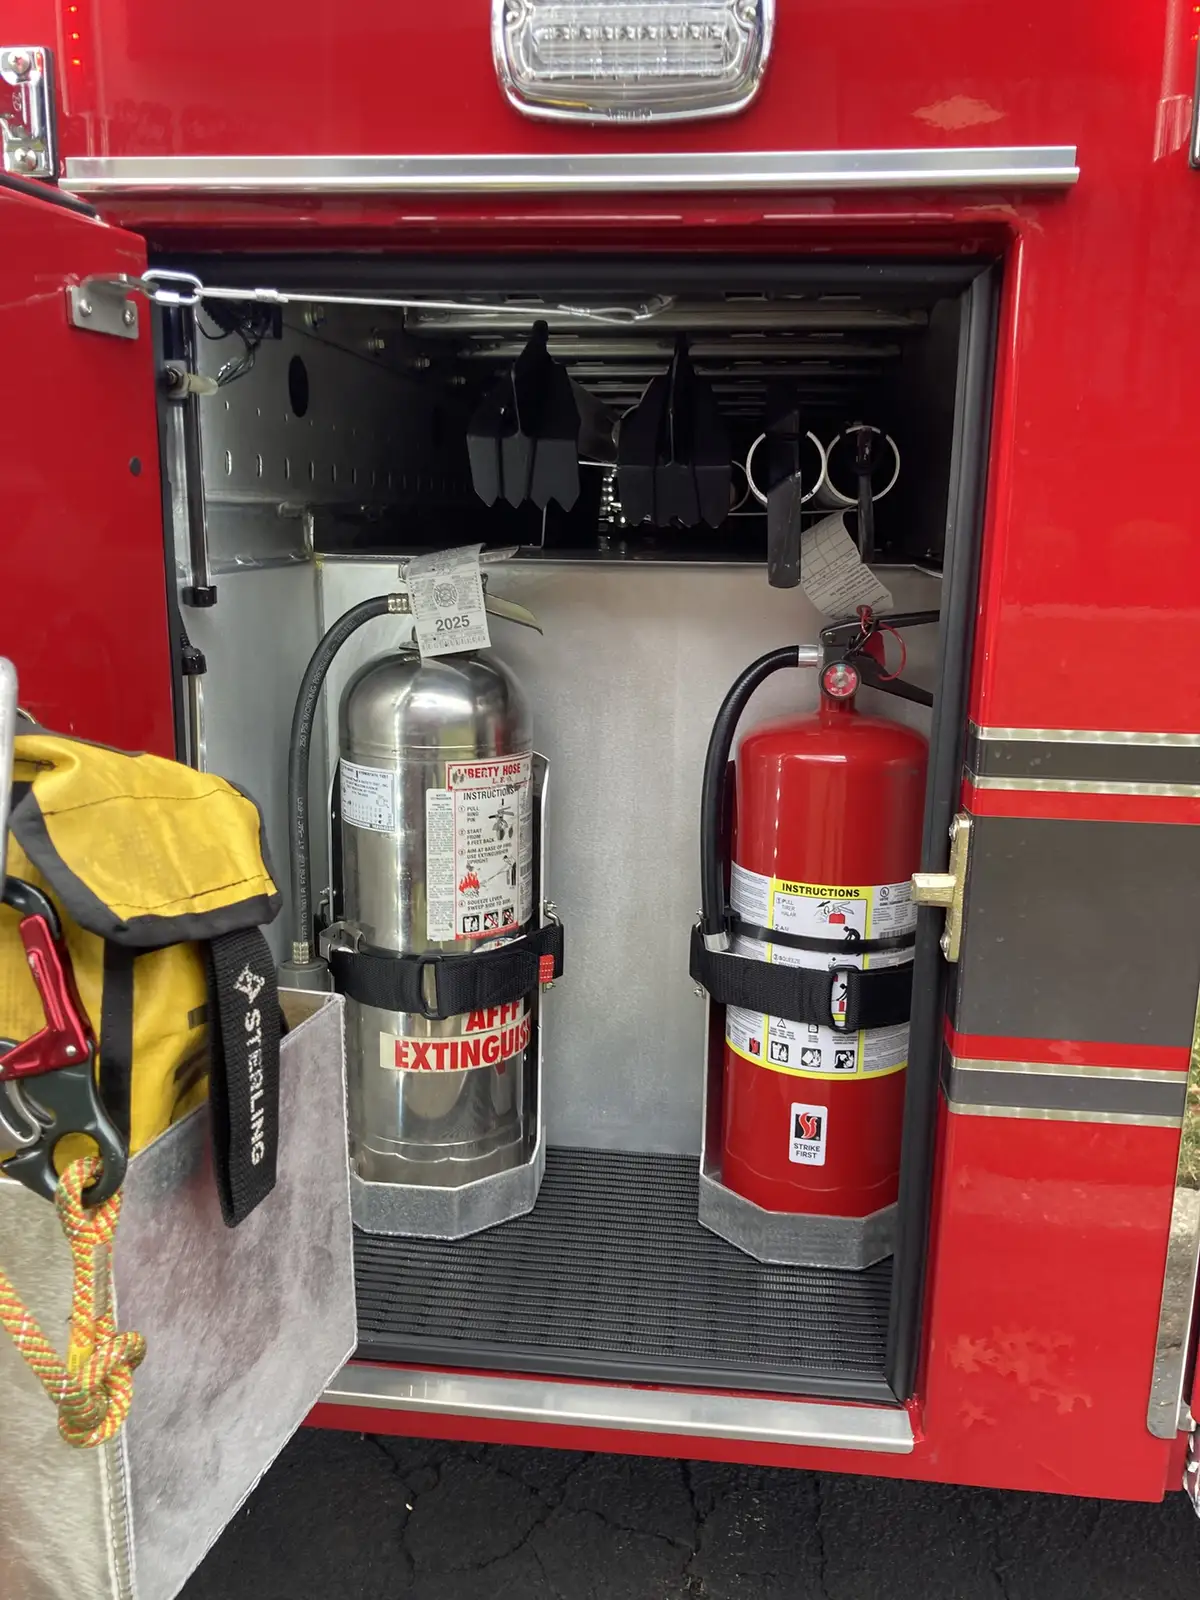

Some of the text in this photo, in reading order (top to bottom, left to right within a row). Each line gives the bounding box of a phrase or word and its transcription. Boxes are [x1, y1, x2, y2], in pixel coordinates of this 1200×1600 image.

[435, 615, 470, 632] 2025
[303, 685, 317, 720] WORKING
[503, 762, 521, 776] HOSE
[463, 786, 515, 801] INSTRUCTIONS
[782, 882, 860, 898] INSTRUCTIONS
[782, 898, 794, 906] PULL
[243, 1008, 265, 1165] STERLING
[793, 1143, 821, 1152] STRIKE
[795, 1150, 817, 1159] FIRST
